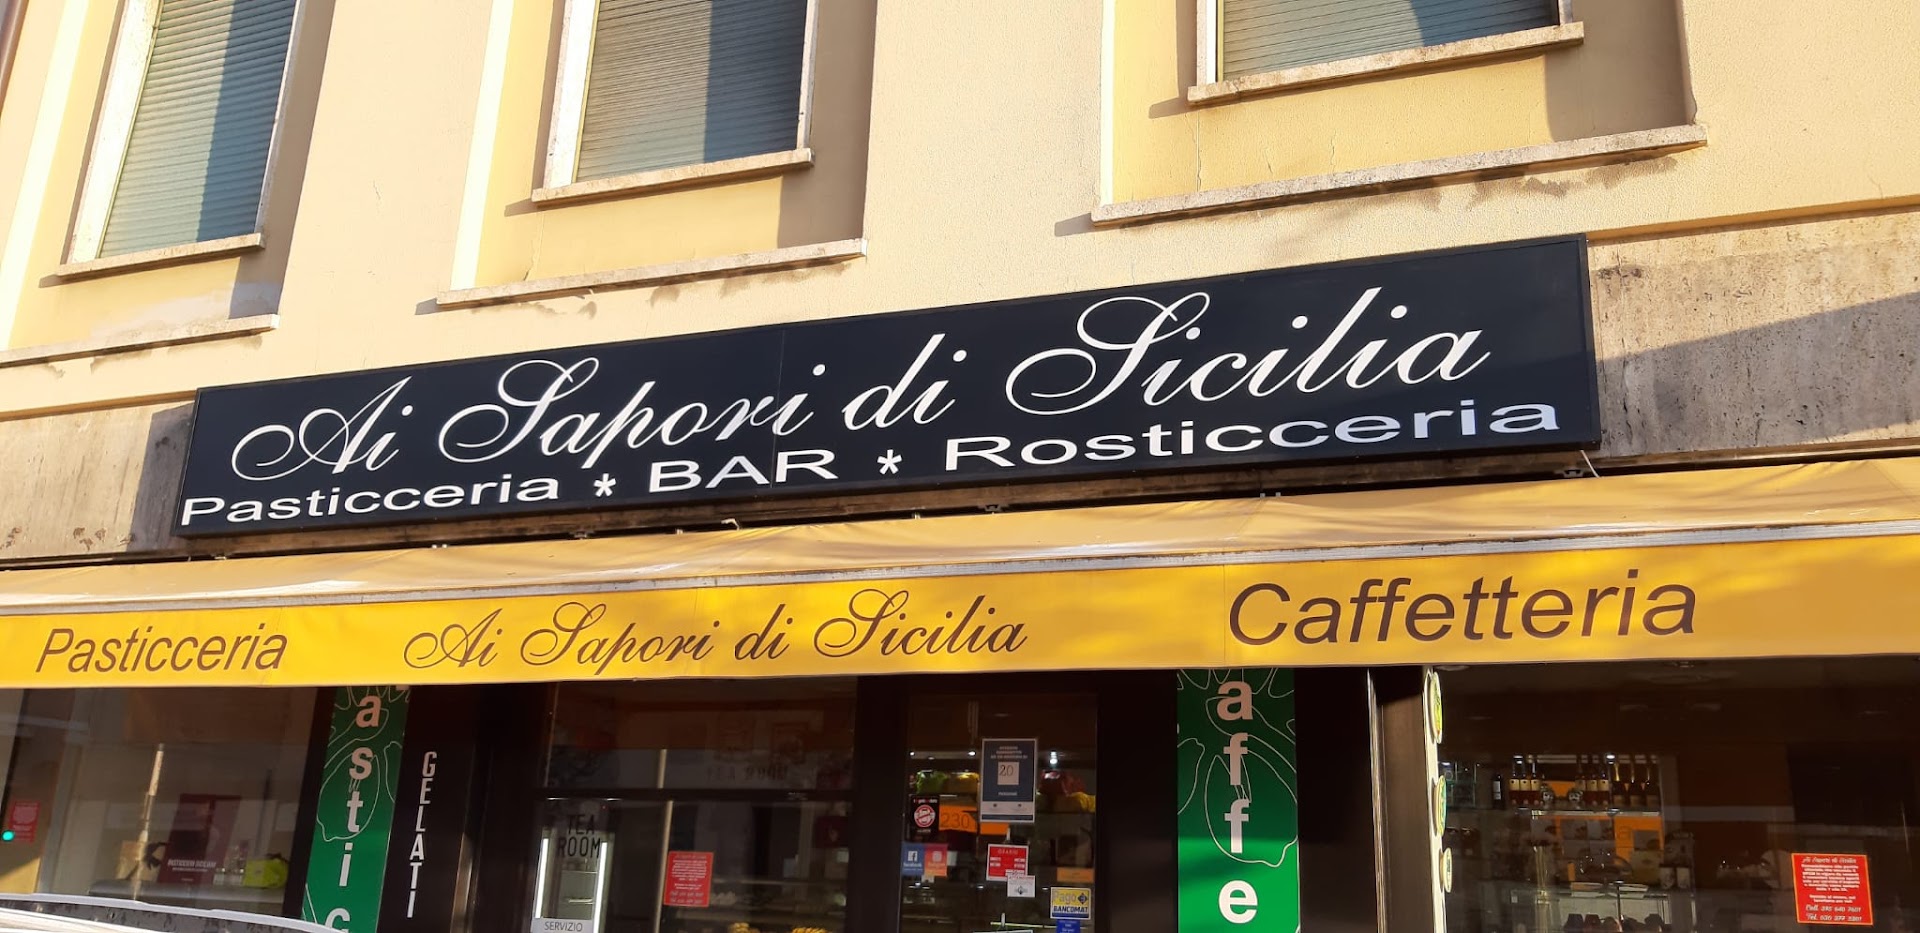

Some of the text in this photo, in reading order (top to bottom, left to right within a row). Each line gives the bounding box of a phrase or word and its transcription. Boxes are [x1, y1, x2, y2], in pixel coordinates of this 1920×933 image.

[231, 287, 1492, 482] Ai Sapori di Sicilia
[181, 400, 1561, 527] Pasticceria BAR Rosticceria
[1228, 568, 1698, 647] Caffetteria
[403, 588, 1028, 670] Ai Sapori di Sicilia
[36, 622, 289, 674] Pasticceria
[998, 764, 1014, 777] 20
[406, 750, 438, 919] GELATI
[566, 814, 596, 836] TEA
[556, 836, 601, 859] ROOM
[1053, 889, 1077, 905] Pago
[1053, 905, 1089, 913] BANCOMAT
[544, 921, 583, 932] SERVIZIO
